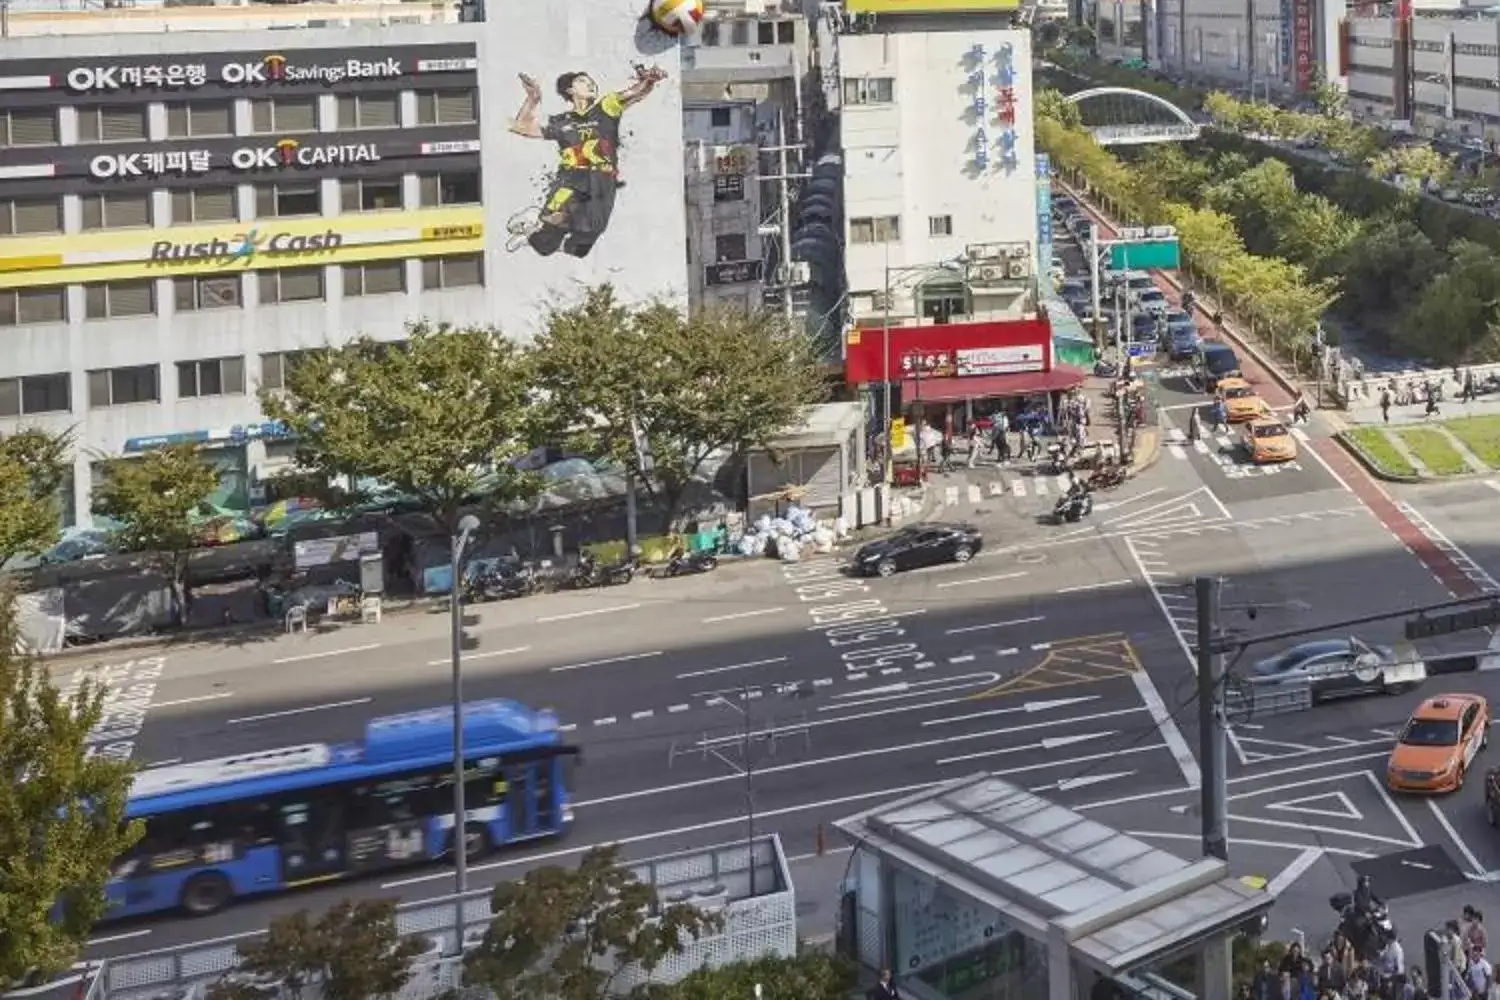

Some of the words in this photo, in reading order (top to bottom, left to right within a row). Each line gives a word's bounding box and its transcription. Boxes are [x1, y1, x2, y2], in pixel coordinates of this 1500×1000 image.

[297, 144, 381, 165] CAPITAL
[151, 237, 229, 260] Rush
[269, 228, 342, 252] Cash
